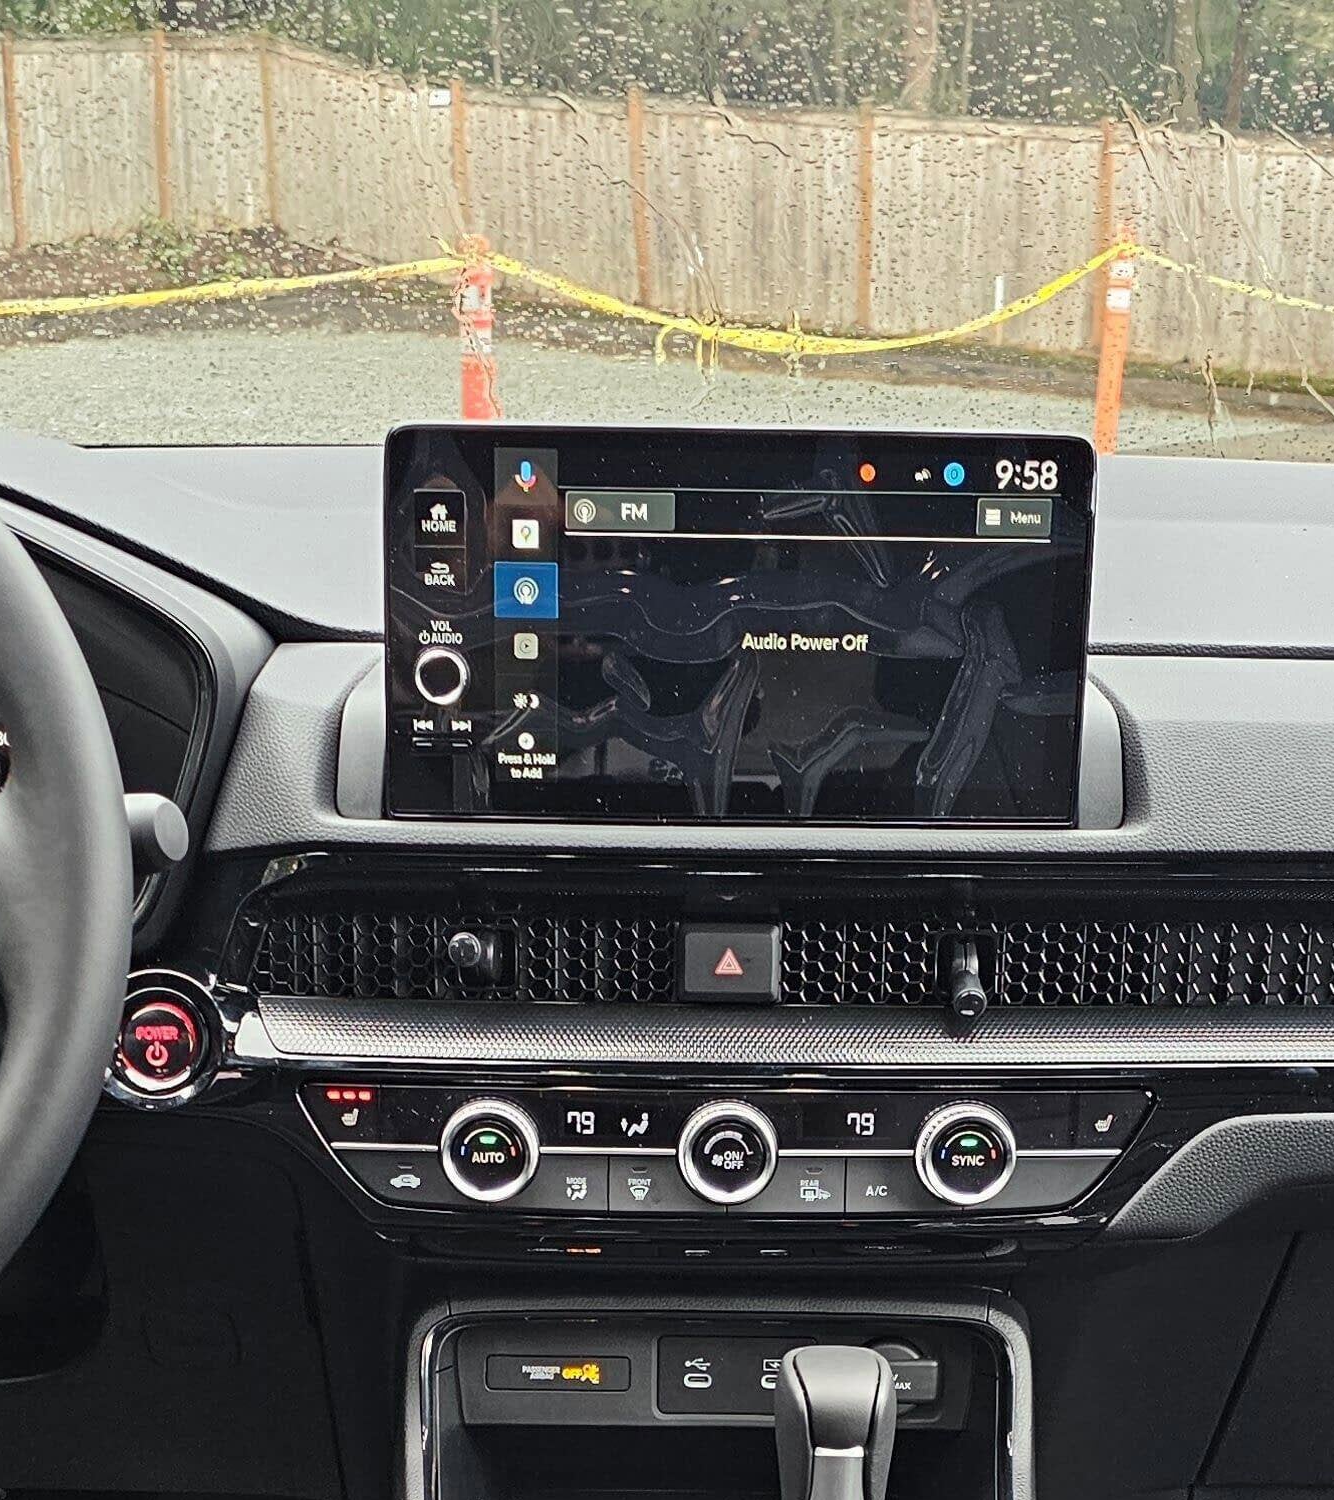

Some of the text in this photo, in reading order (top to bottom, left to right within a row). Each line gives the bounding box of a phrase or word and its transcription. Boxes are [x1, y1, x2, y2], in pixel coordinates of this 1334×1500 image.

[995, 459, 1059, 491] 9:58
[620, 502, 648, 521] FM
[1010, 510, 1041, 525] Menu
[421, 519, 457, 533] HOME
[424, 573, 456, 587] BACK
[430, 620, 453, 632] VOL
[431, 632, 463, 645] AUDIO
[741, 632, 869, 652] Audio Power Off
[497, 752, 557, 766] Press & Hold
[510, 767, 543, 779] to Add
[135, 1025, 179, 1041] POWER
[567, 1111, 596, 1135] 79
[846, 1112, 875, 1136] 79
[471, 1151, 505, 1164] AUTO
[723, 1151, 744, 1162] ON/
[951, 1155, 986, 1167] SYNC
[723, 1160, 744, 1170] OFF
[627, 1178, 651, 1187] FRONT
[865, 1185, 888, 1197] A/C
